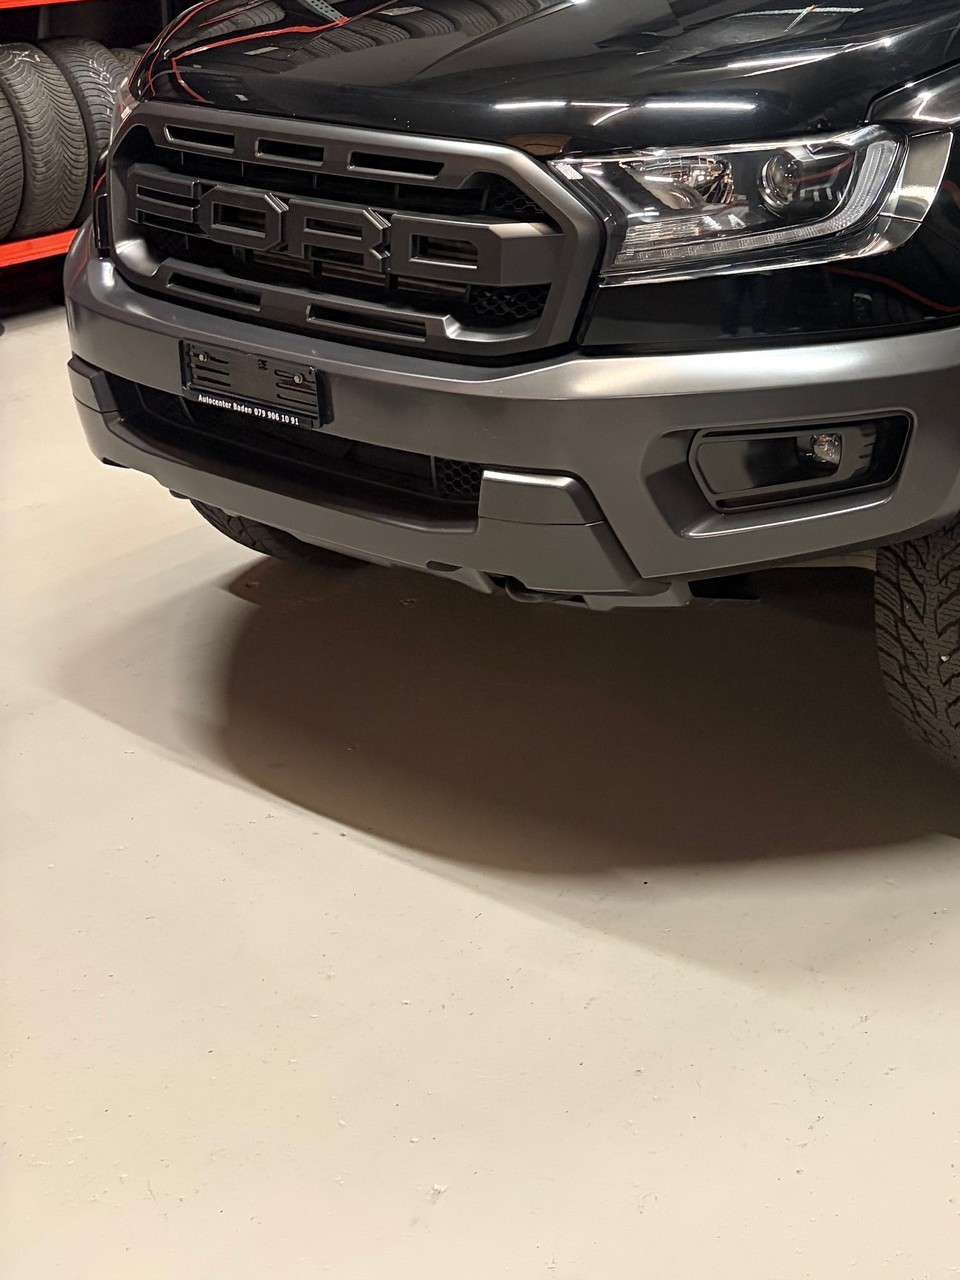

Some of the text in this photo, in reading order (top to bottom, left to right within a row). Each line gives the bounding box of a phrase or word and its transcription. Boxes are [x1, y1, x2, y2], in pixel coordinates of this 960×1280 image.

[126, 163, 503, 286] FORD
[198, 394, 300, 426] Autocenter Baden 079 906 10 91
